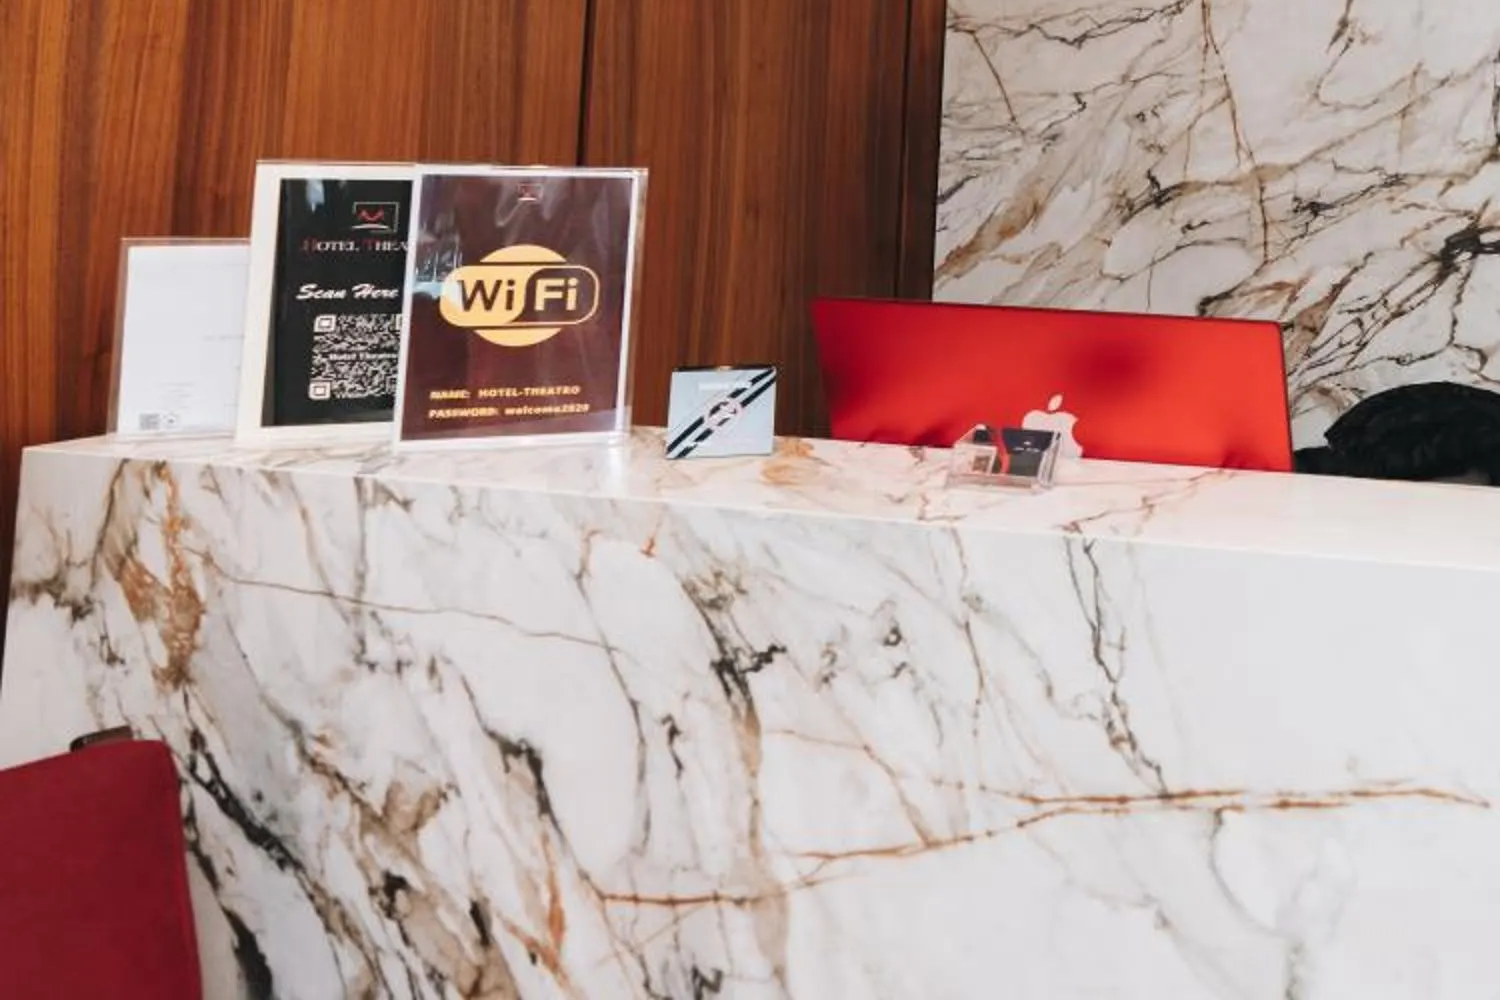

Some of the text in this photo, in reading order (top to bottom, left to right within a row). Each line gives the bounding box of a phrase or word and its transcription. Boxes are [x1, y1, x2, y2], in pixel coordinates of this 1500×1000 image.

[295, 283, 399, 300] Scan Here
[477, 384, 582, 399] HOTEL-THEATRO
